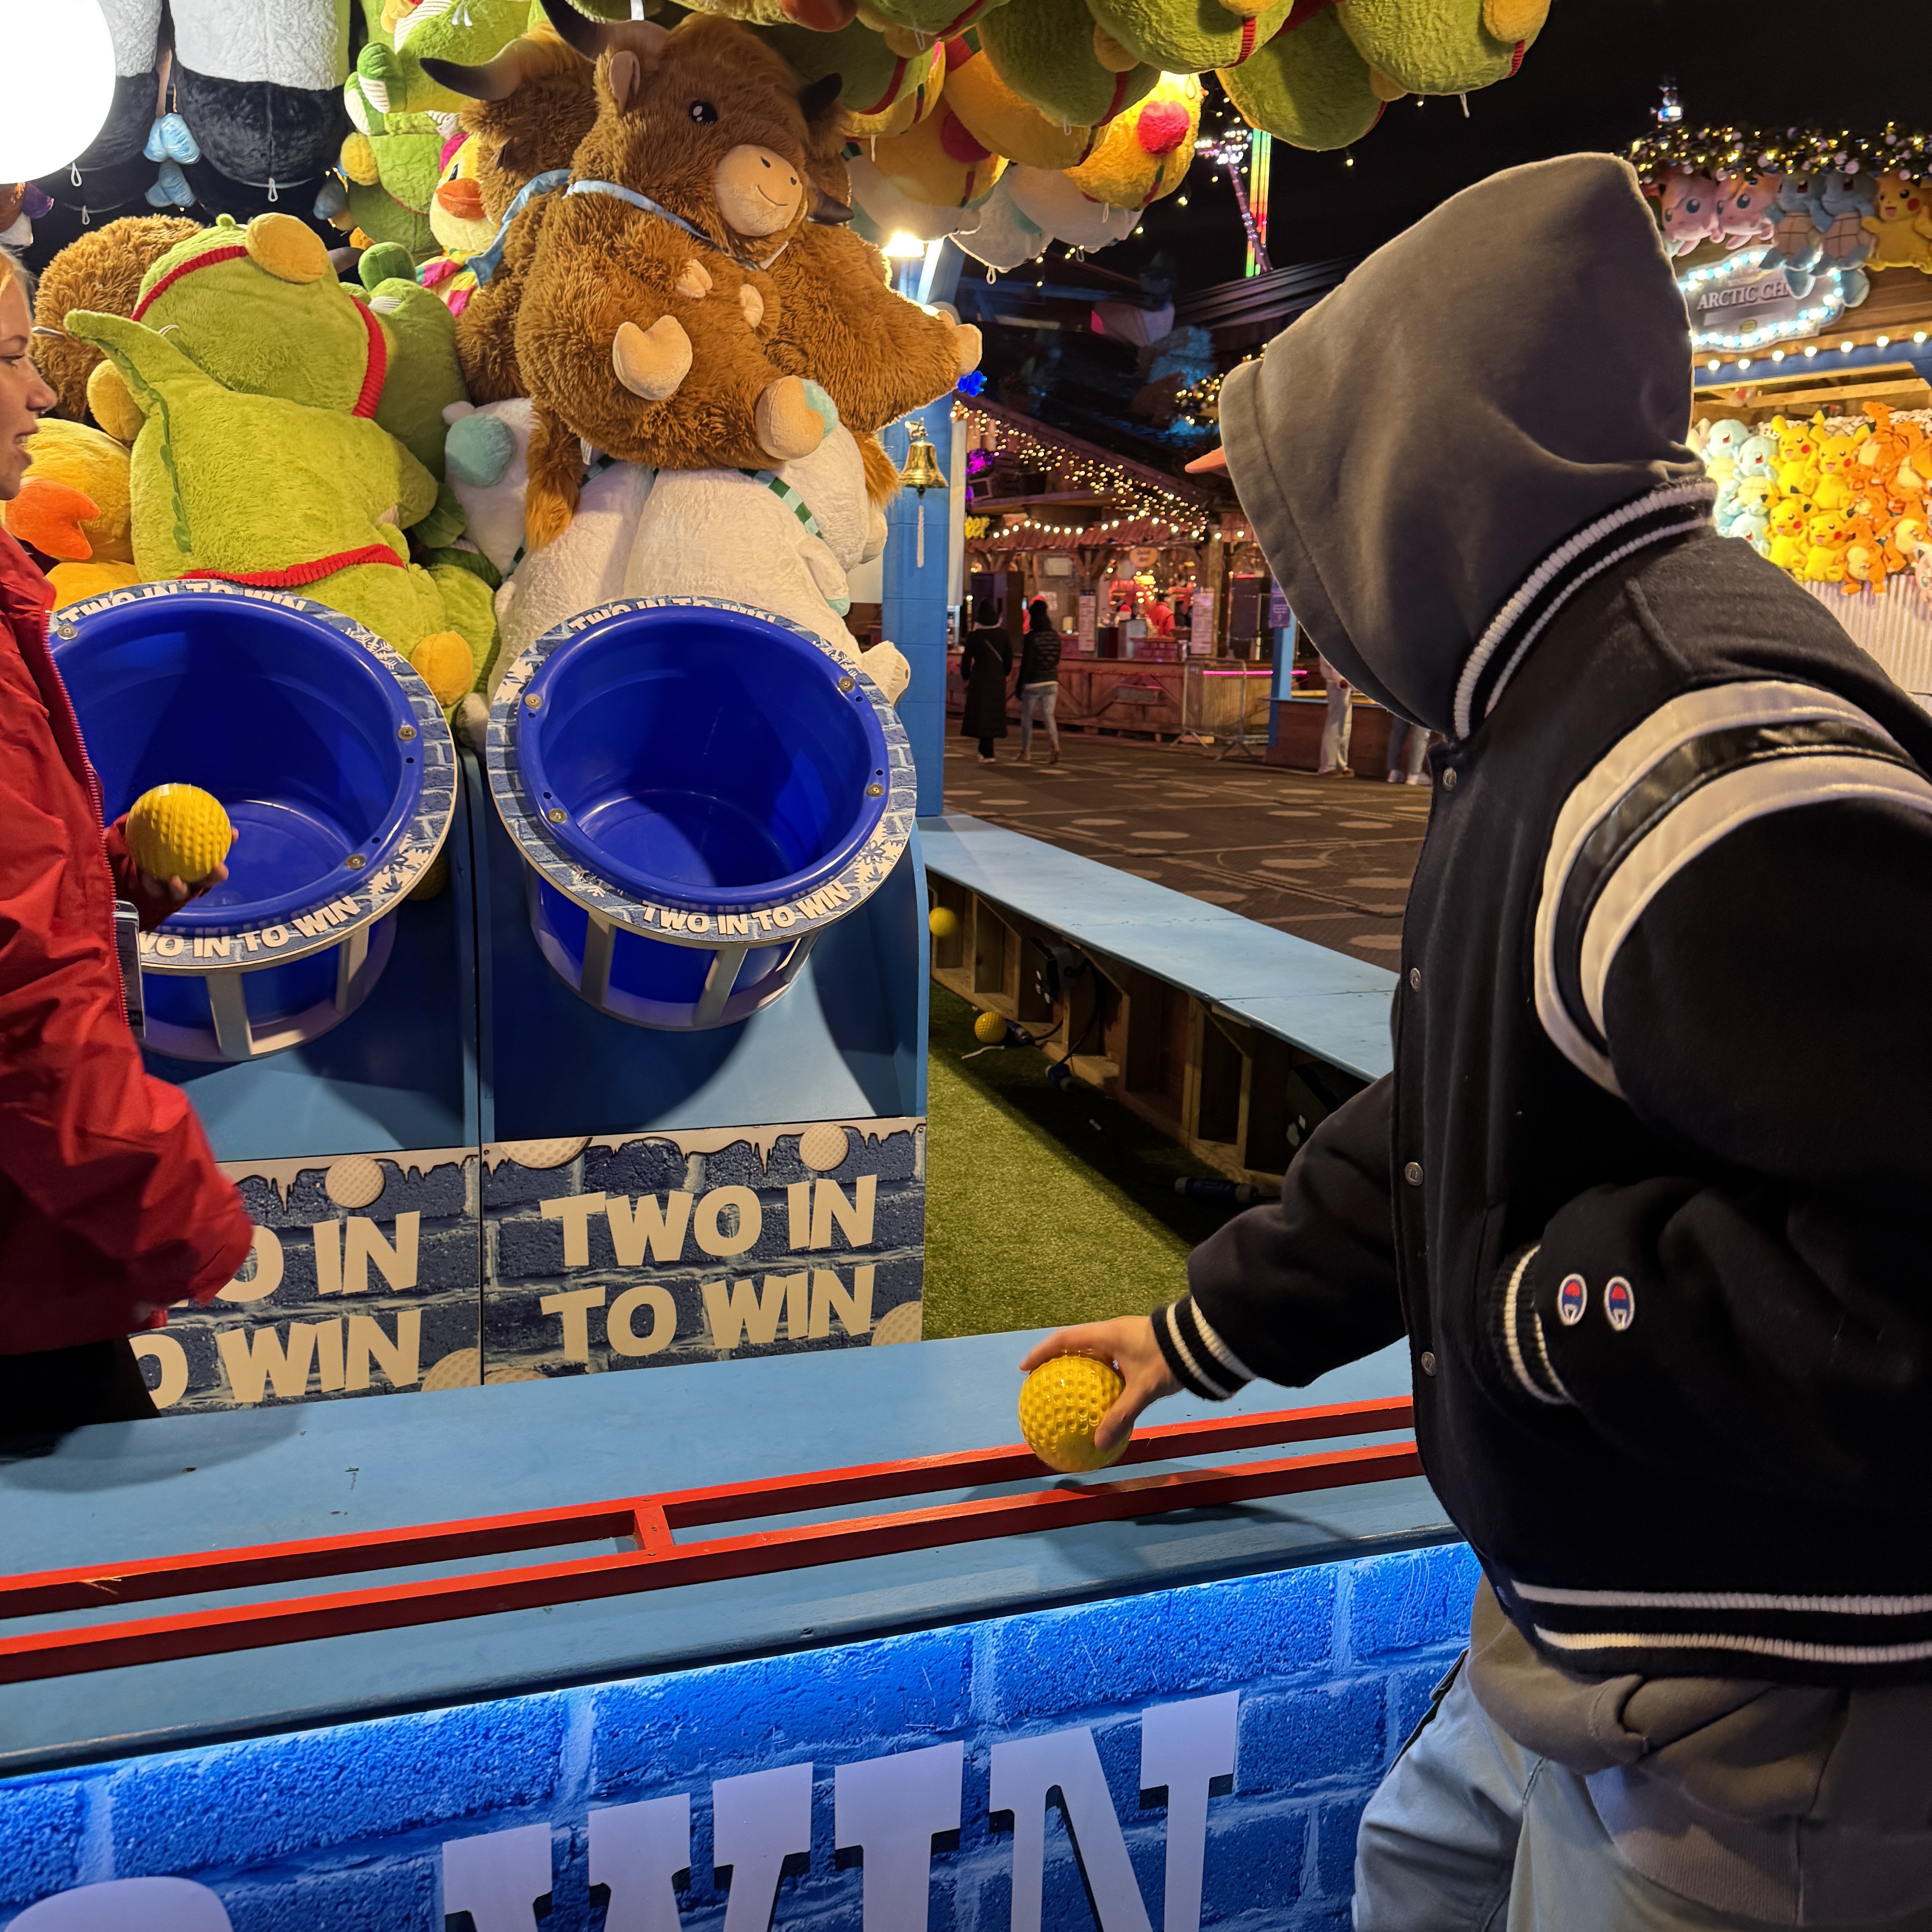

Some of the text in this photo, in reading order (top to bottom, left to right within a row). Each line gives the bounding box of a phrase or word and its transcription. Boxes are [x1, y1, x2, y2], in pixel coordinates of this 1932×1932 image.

[1697, 286, 1757, 310] ARCTIC
[139, 895, 361, 957] WO IN TO WIN
[642, 880, 852, 935] TWO IN TO WIN
[313, 1211, 420, 1295] IN
[540, 1174, 877, 1266] TWO IN
[540, 1265, 875, 1362] TO WIN
[128, 1309, 421, 1409] O WIN
